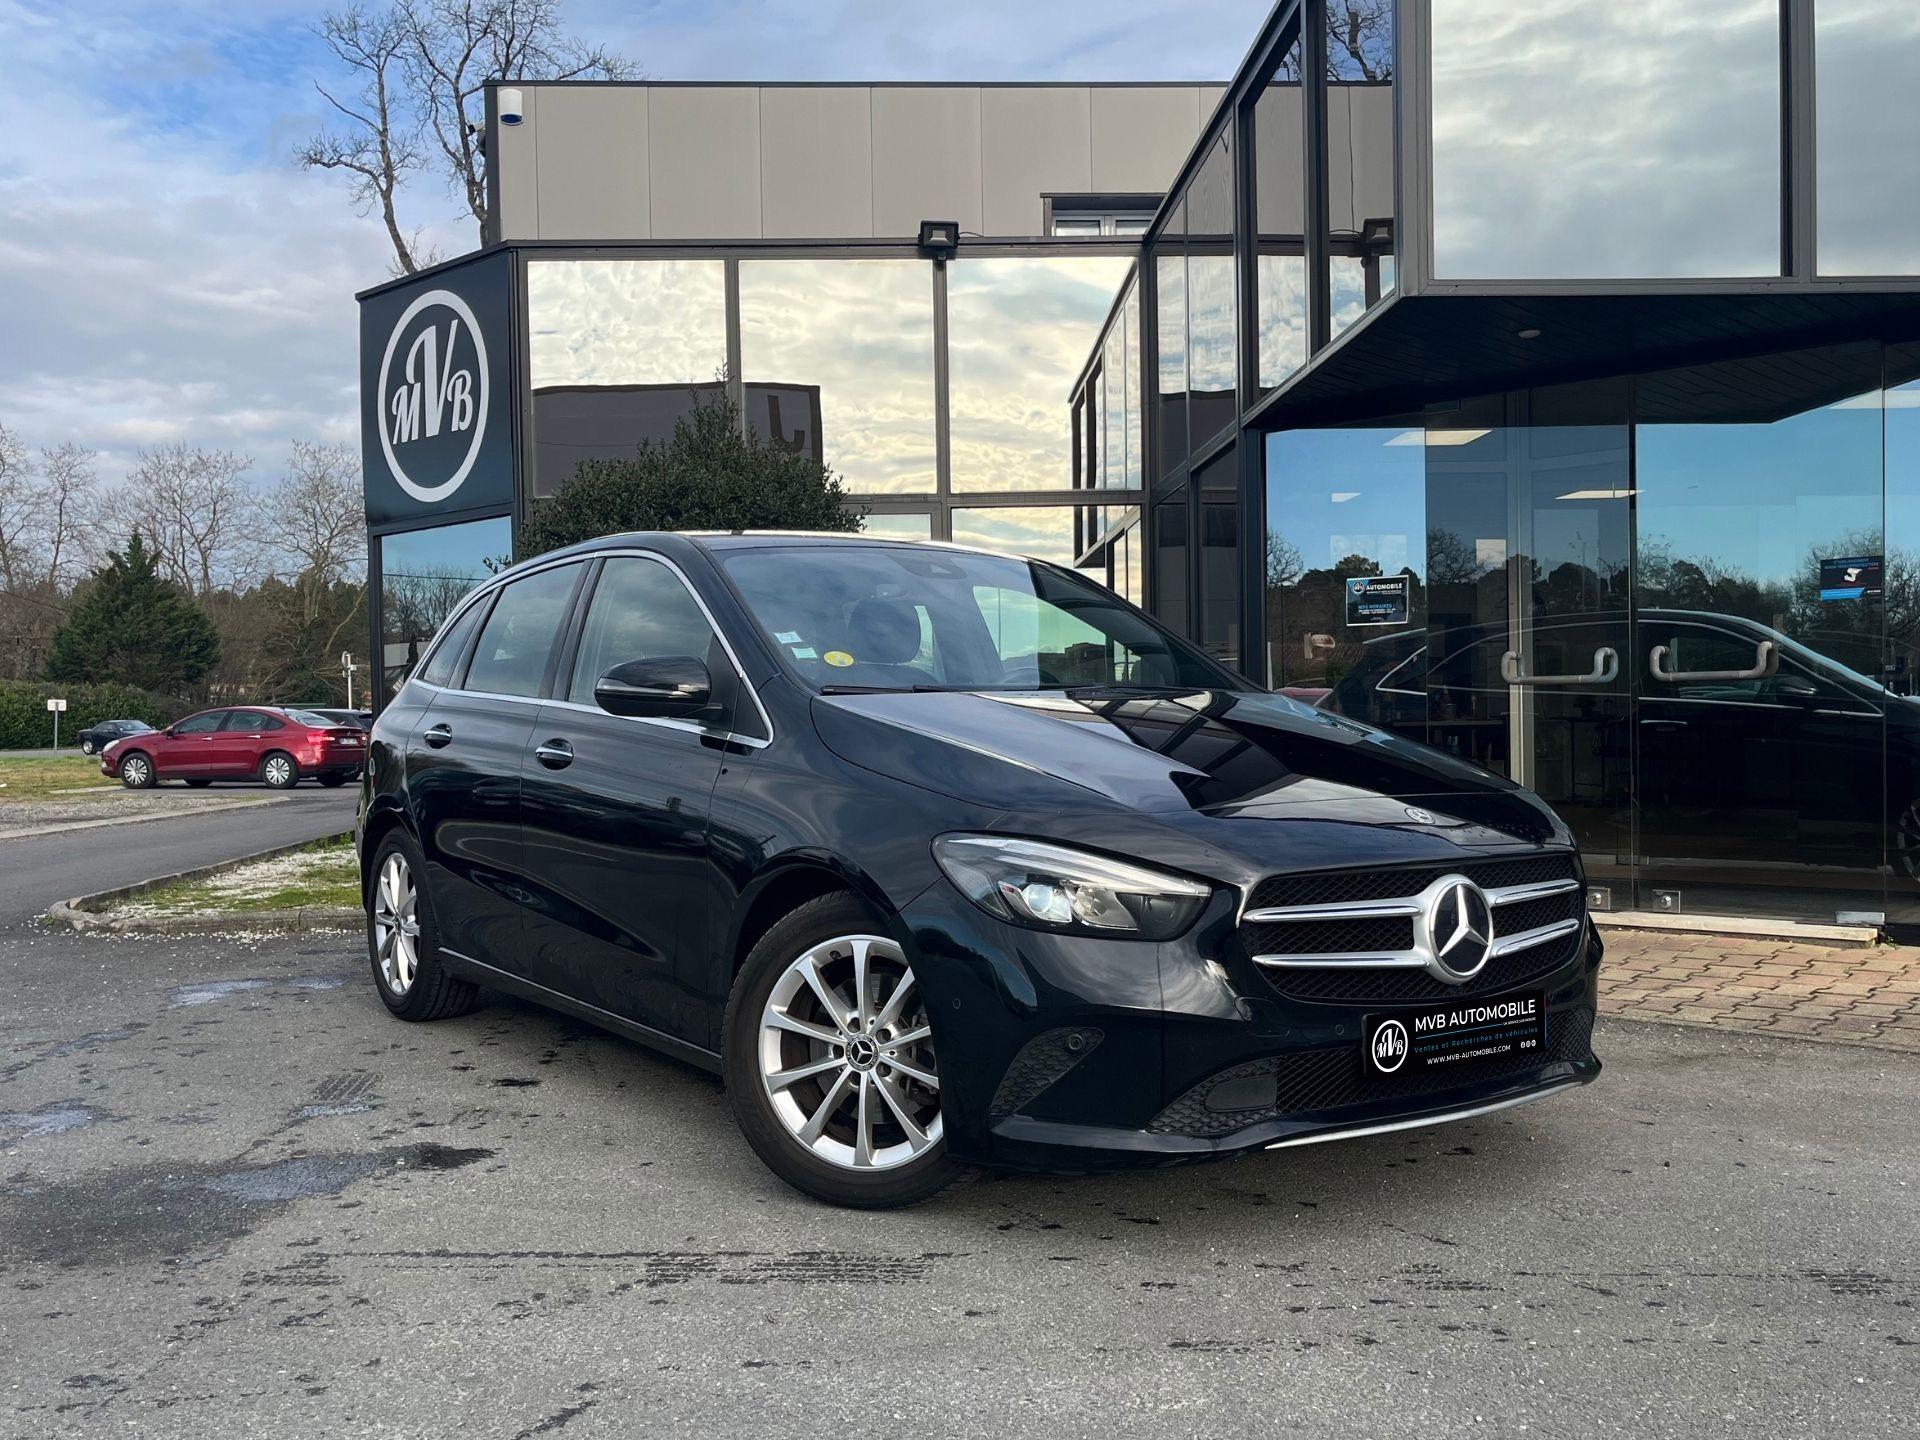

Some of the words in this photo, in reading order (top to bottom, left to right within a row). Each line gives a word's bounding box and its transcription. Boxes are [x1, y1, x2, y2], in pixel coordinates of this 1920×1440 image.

[392, 319, 473, 445] MVB
[1366, 583, 1402, 591] AUTOMOBILE
[1415, 1013, 1446, 1032] MVB
[1449, 999, 1536, 1027] AUTOMOBILE
[1376, 1027, 1404, 1059] MVB
[1427, 1044, 1511, 1065] WWW.MVB-AUTOMOBILE.COM
